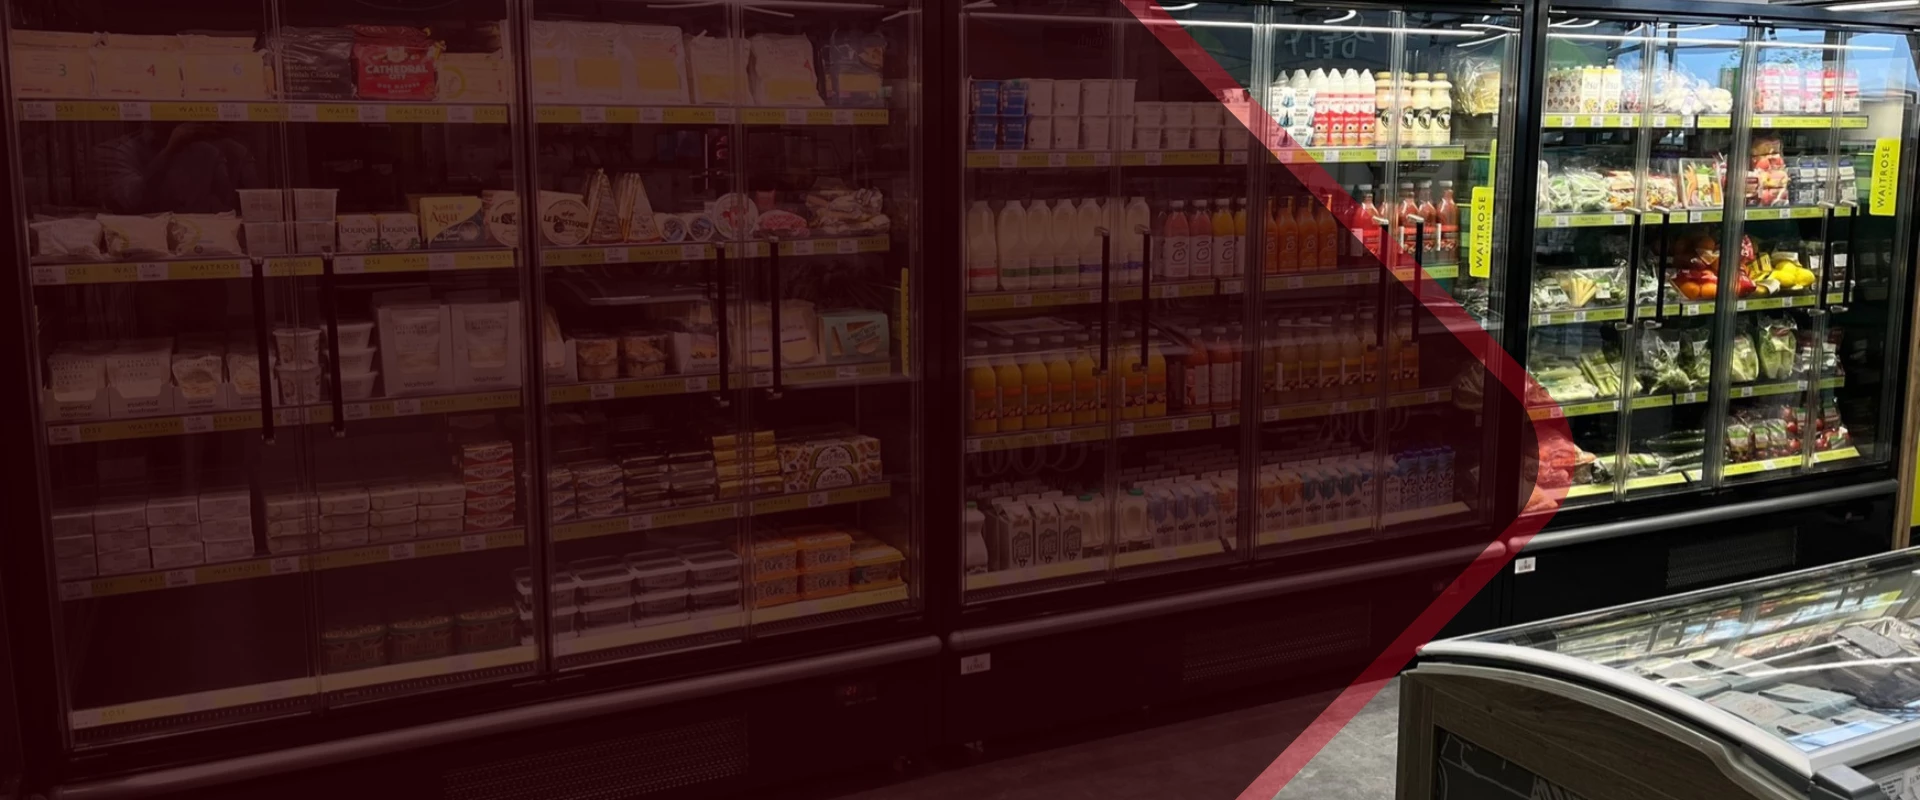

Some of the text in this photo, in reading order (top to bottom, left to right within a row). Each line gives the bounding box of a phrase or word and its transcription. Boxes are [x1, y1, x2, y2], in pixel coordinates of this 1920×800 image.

[147, 63, 156, 77] 4
[365, 64, 429, 75] CATHEDRAL
[1877, 146, 1890, 208] WAITROSE
[341, 224, 376, 235] boursin
[382, 223, 416, 235] boursin
[1476, 196, 1486, 269] WAITROSE
[189, 263, 241, 272] WAITROSE
[128, 421, 178, 431] WAITROSE
[212, 563, 262, 575] WAITROSE
[764, 560, 783, 571] Pure
[818, 578, 837, 589] Pure
